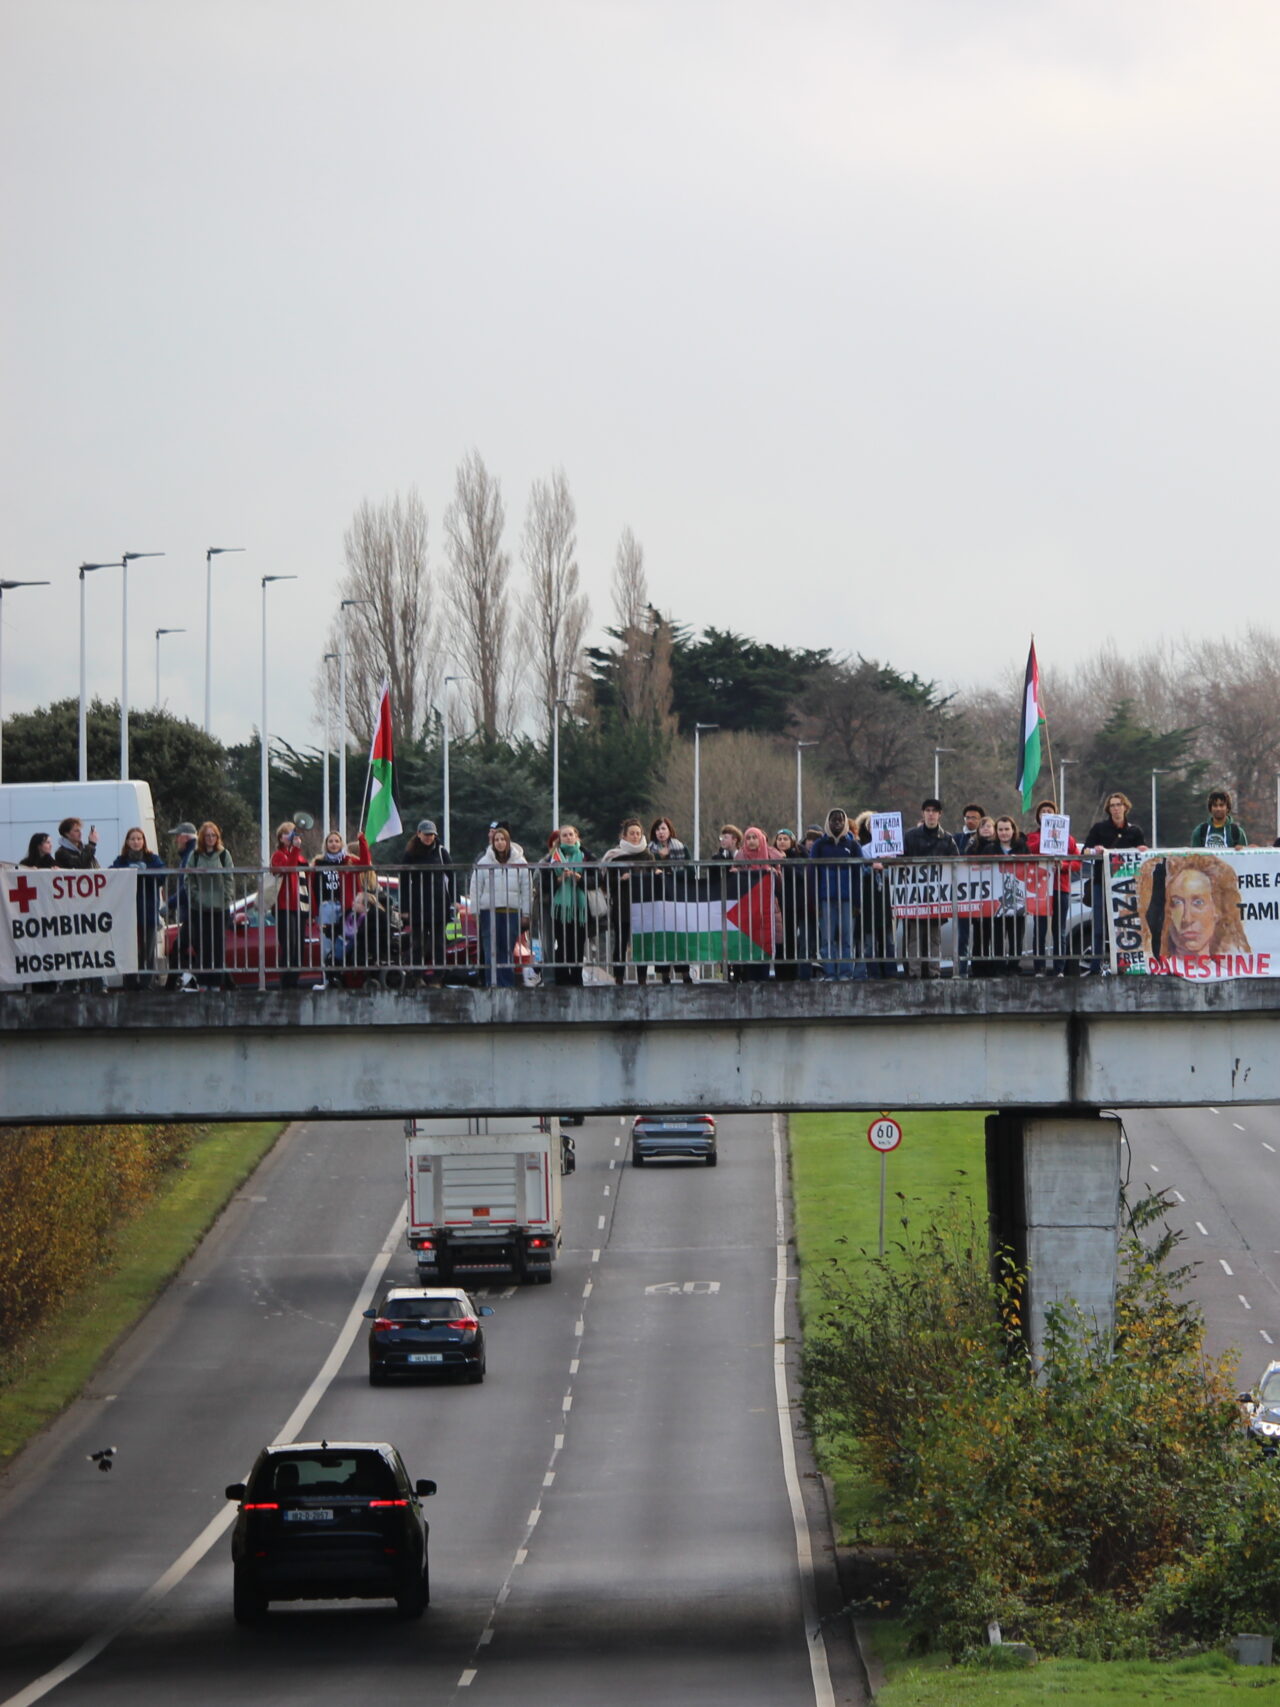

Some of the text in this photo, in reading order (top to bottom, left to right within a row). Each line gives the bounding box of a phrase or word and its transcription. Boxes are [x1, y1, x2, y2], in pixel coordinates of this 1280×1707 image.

[52, 873, 107, 899] STOP
[890, 864, 942, 885] IRISH
[1238, 873, 1271, 889] FREE
[12, 911, 113, 939] BOMBING
[1111, 878, 1142, 951] GAZA
[15, 950, 116, 974] HOSPITALS
[1148, 953, 1271, 978] PALESTINE
[877, 1124, 893, 1139] 60
